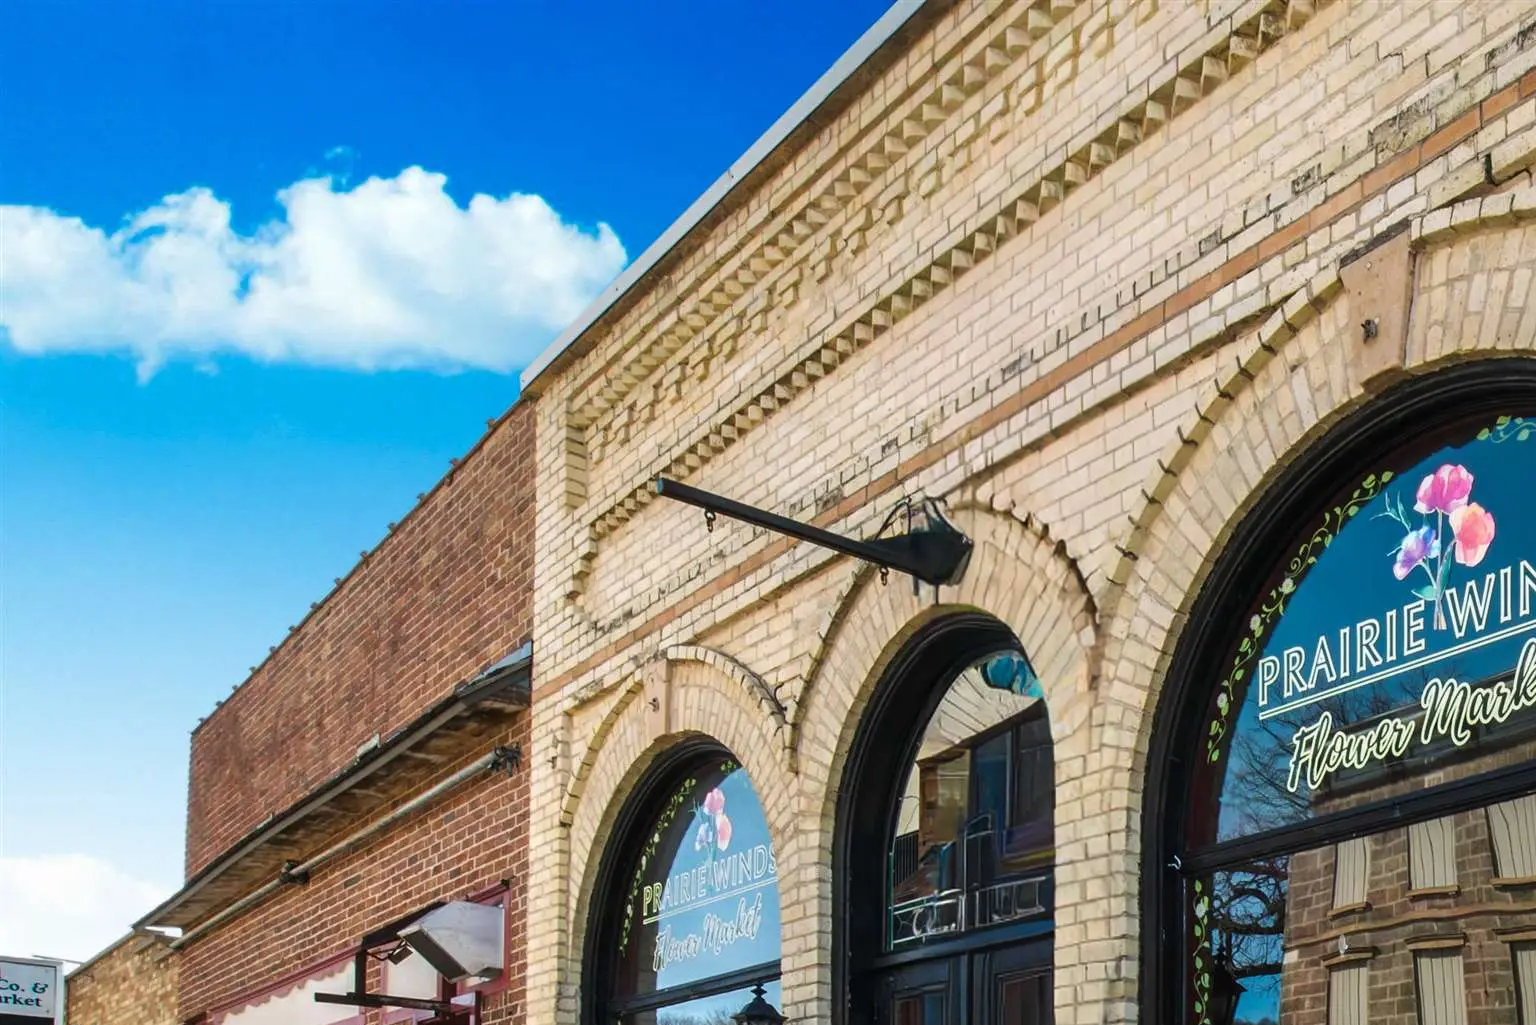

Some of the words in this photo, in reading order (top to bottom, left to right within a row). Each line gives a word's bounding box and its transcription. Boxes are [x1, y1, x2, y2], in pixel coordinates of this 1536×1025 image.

[1258, 600, 1425, 707] PRAIRIE
[1287, 711, 1416, 793] Flower
[643, 866, 707, 917] PRAIRIE
[713, 843, 777, 891] WINDS
[653, 924, 700, 971] Flower
[703, 892, 762, 956] Market
[0, 994, 43, 1008] rket
[32, 982, 49, 994] &
